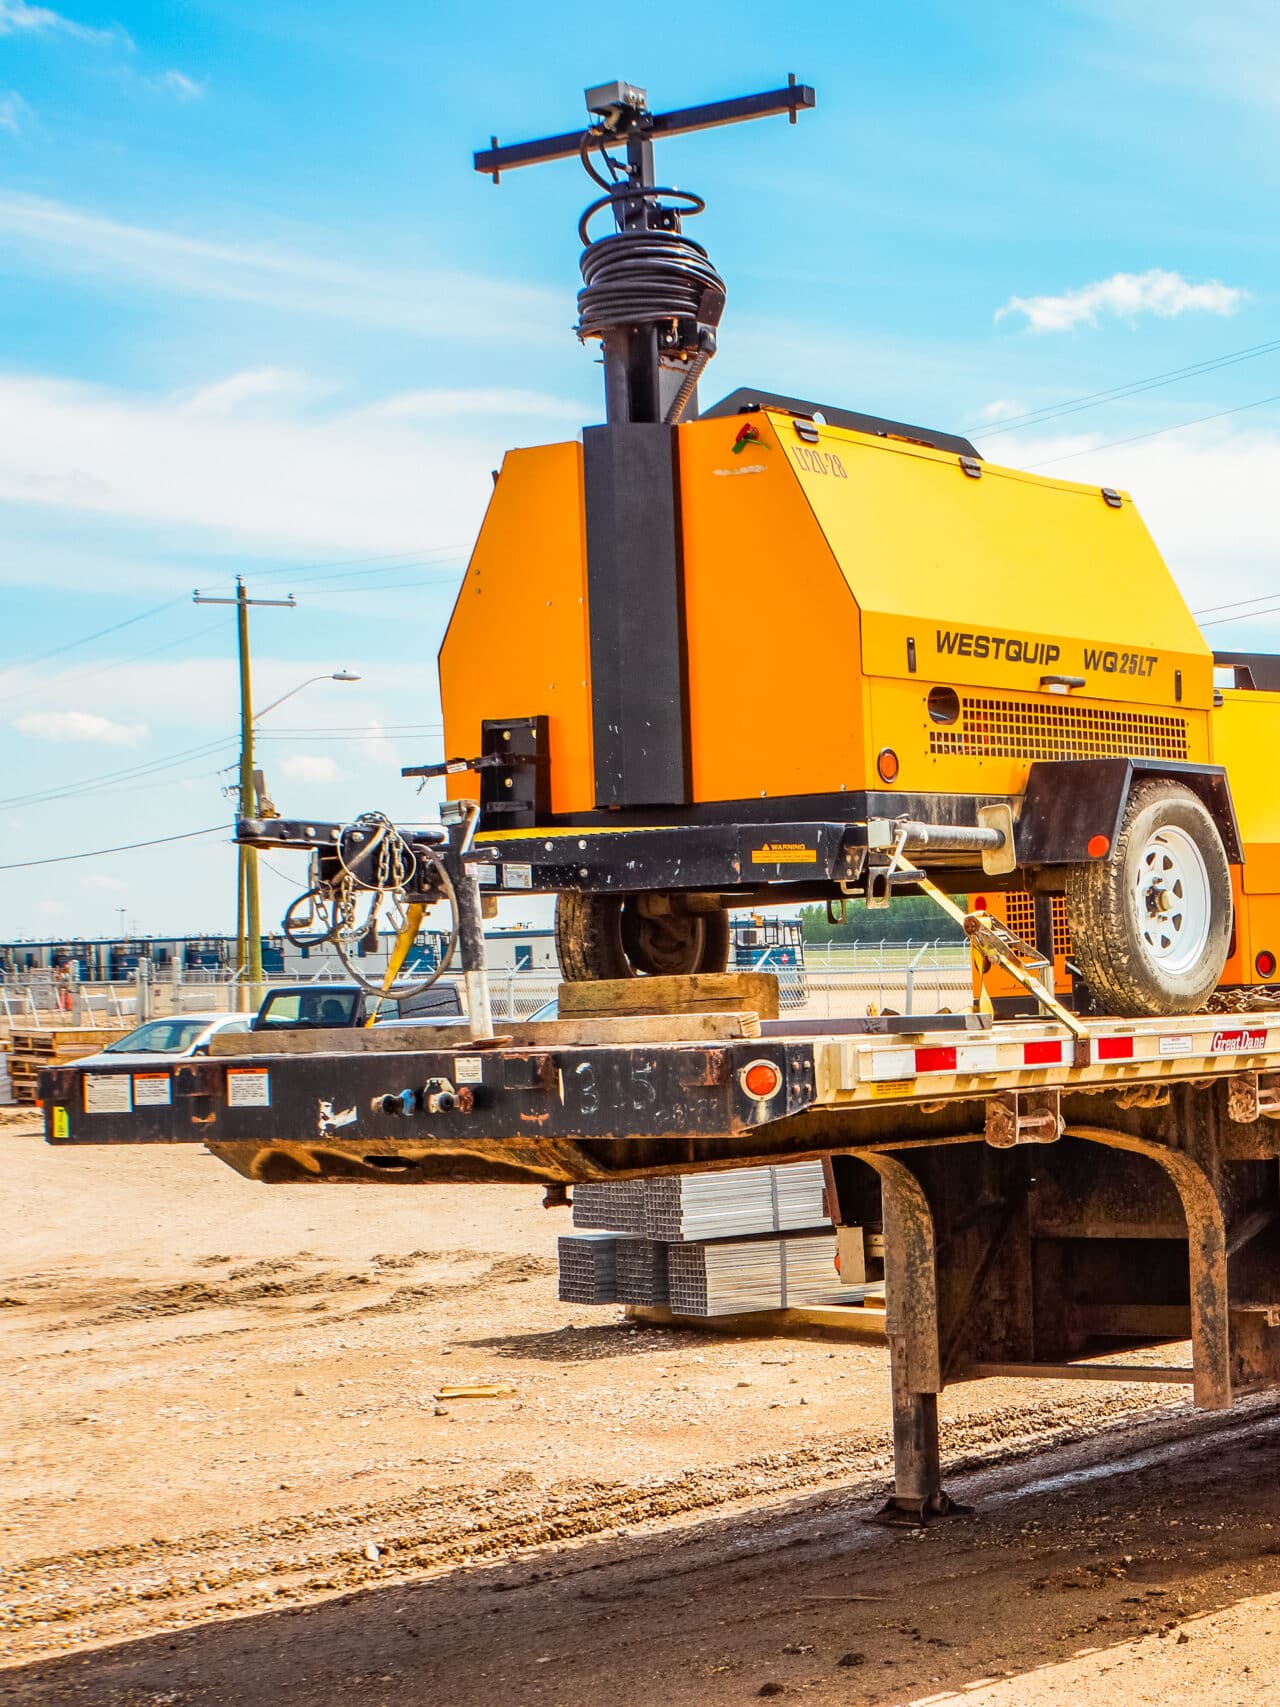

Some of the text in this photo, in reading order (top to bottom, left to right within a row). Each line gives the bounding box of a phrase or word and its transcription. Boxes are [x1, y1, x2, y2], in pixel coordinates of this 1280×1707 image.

[791, 445, 848, 479] LT20-28
[936, 630, 1158, 677] WESTQUIP WQ25LT
[770, 843, 806, 851] WARNING
[1213, 1032, 1240, 1052] Great
[1241, 1031, 1265, 1049] Dane
